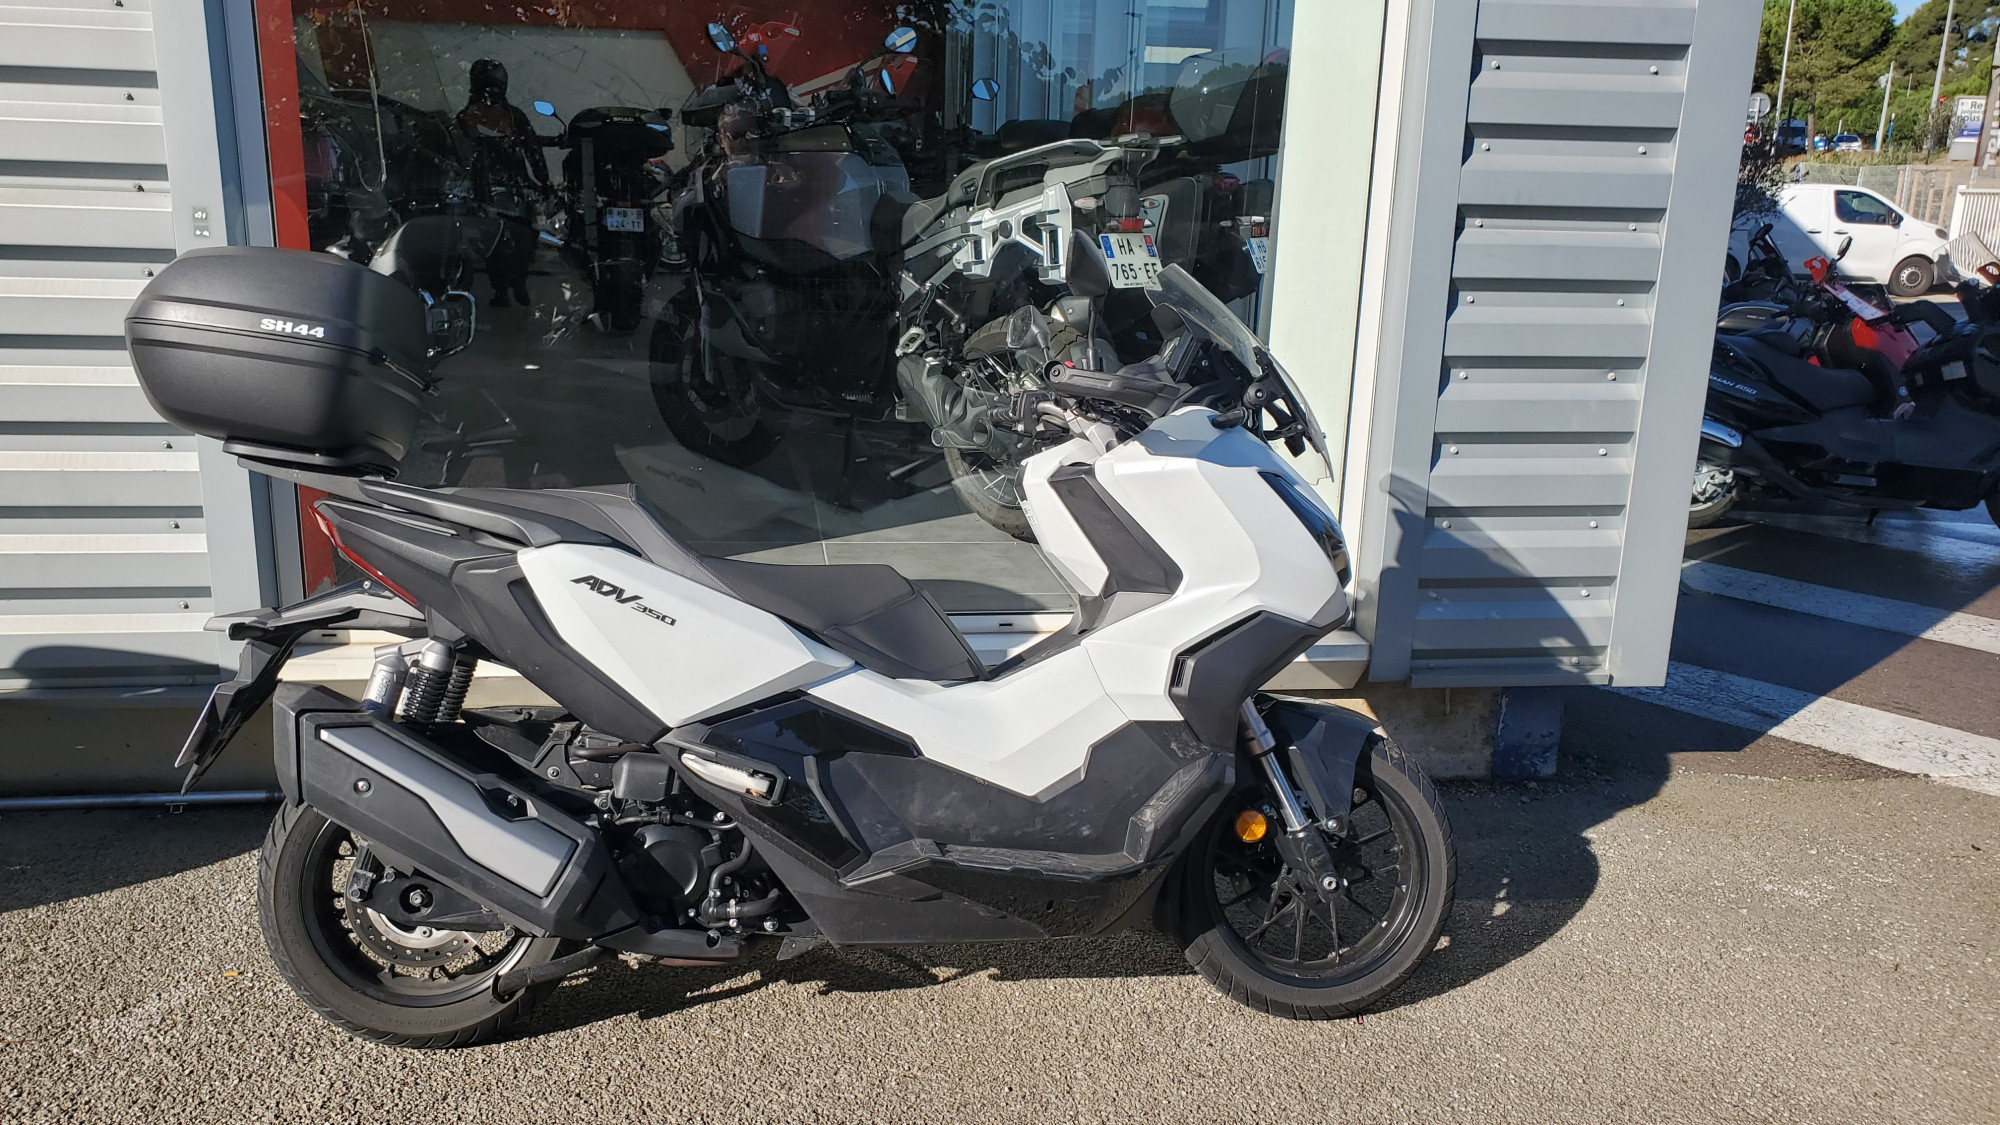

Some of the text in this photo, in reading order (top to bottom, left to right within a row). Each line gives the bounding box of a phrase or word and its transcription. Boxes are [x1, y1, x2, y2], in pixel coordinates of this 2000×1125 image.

[260, 318, 325, 339] SH44
[1735, 384, 1758, 395] 650
[569, 575, 677, 627] ADV 350
